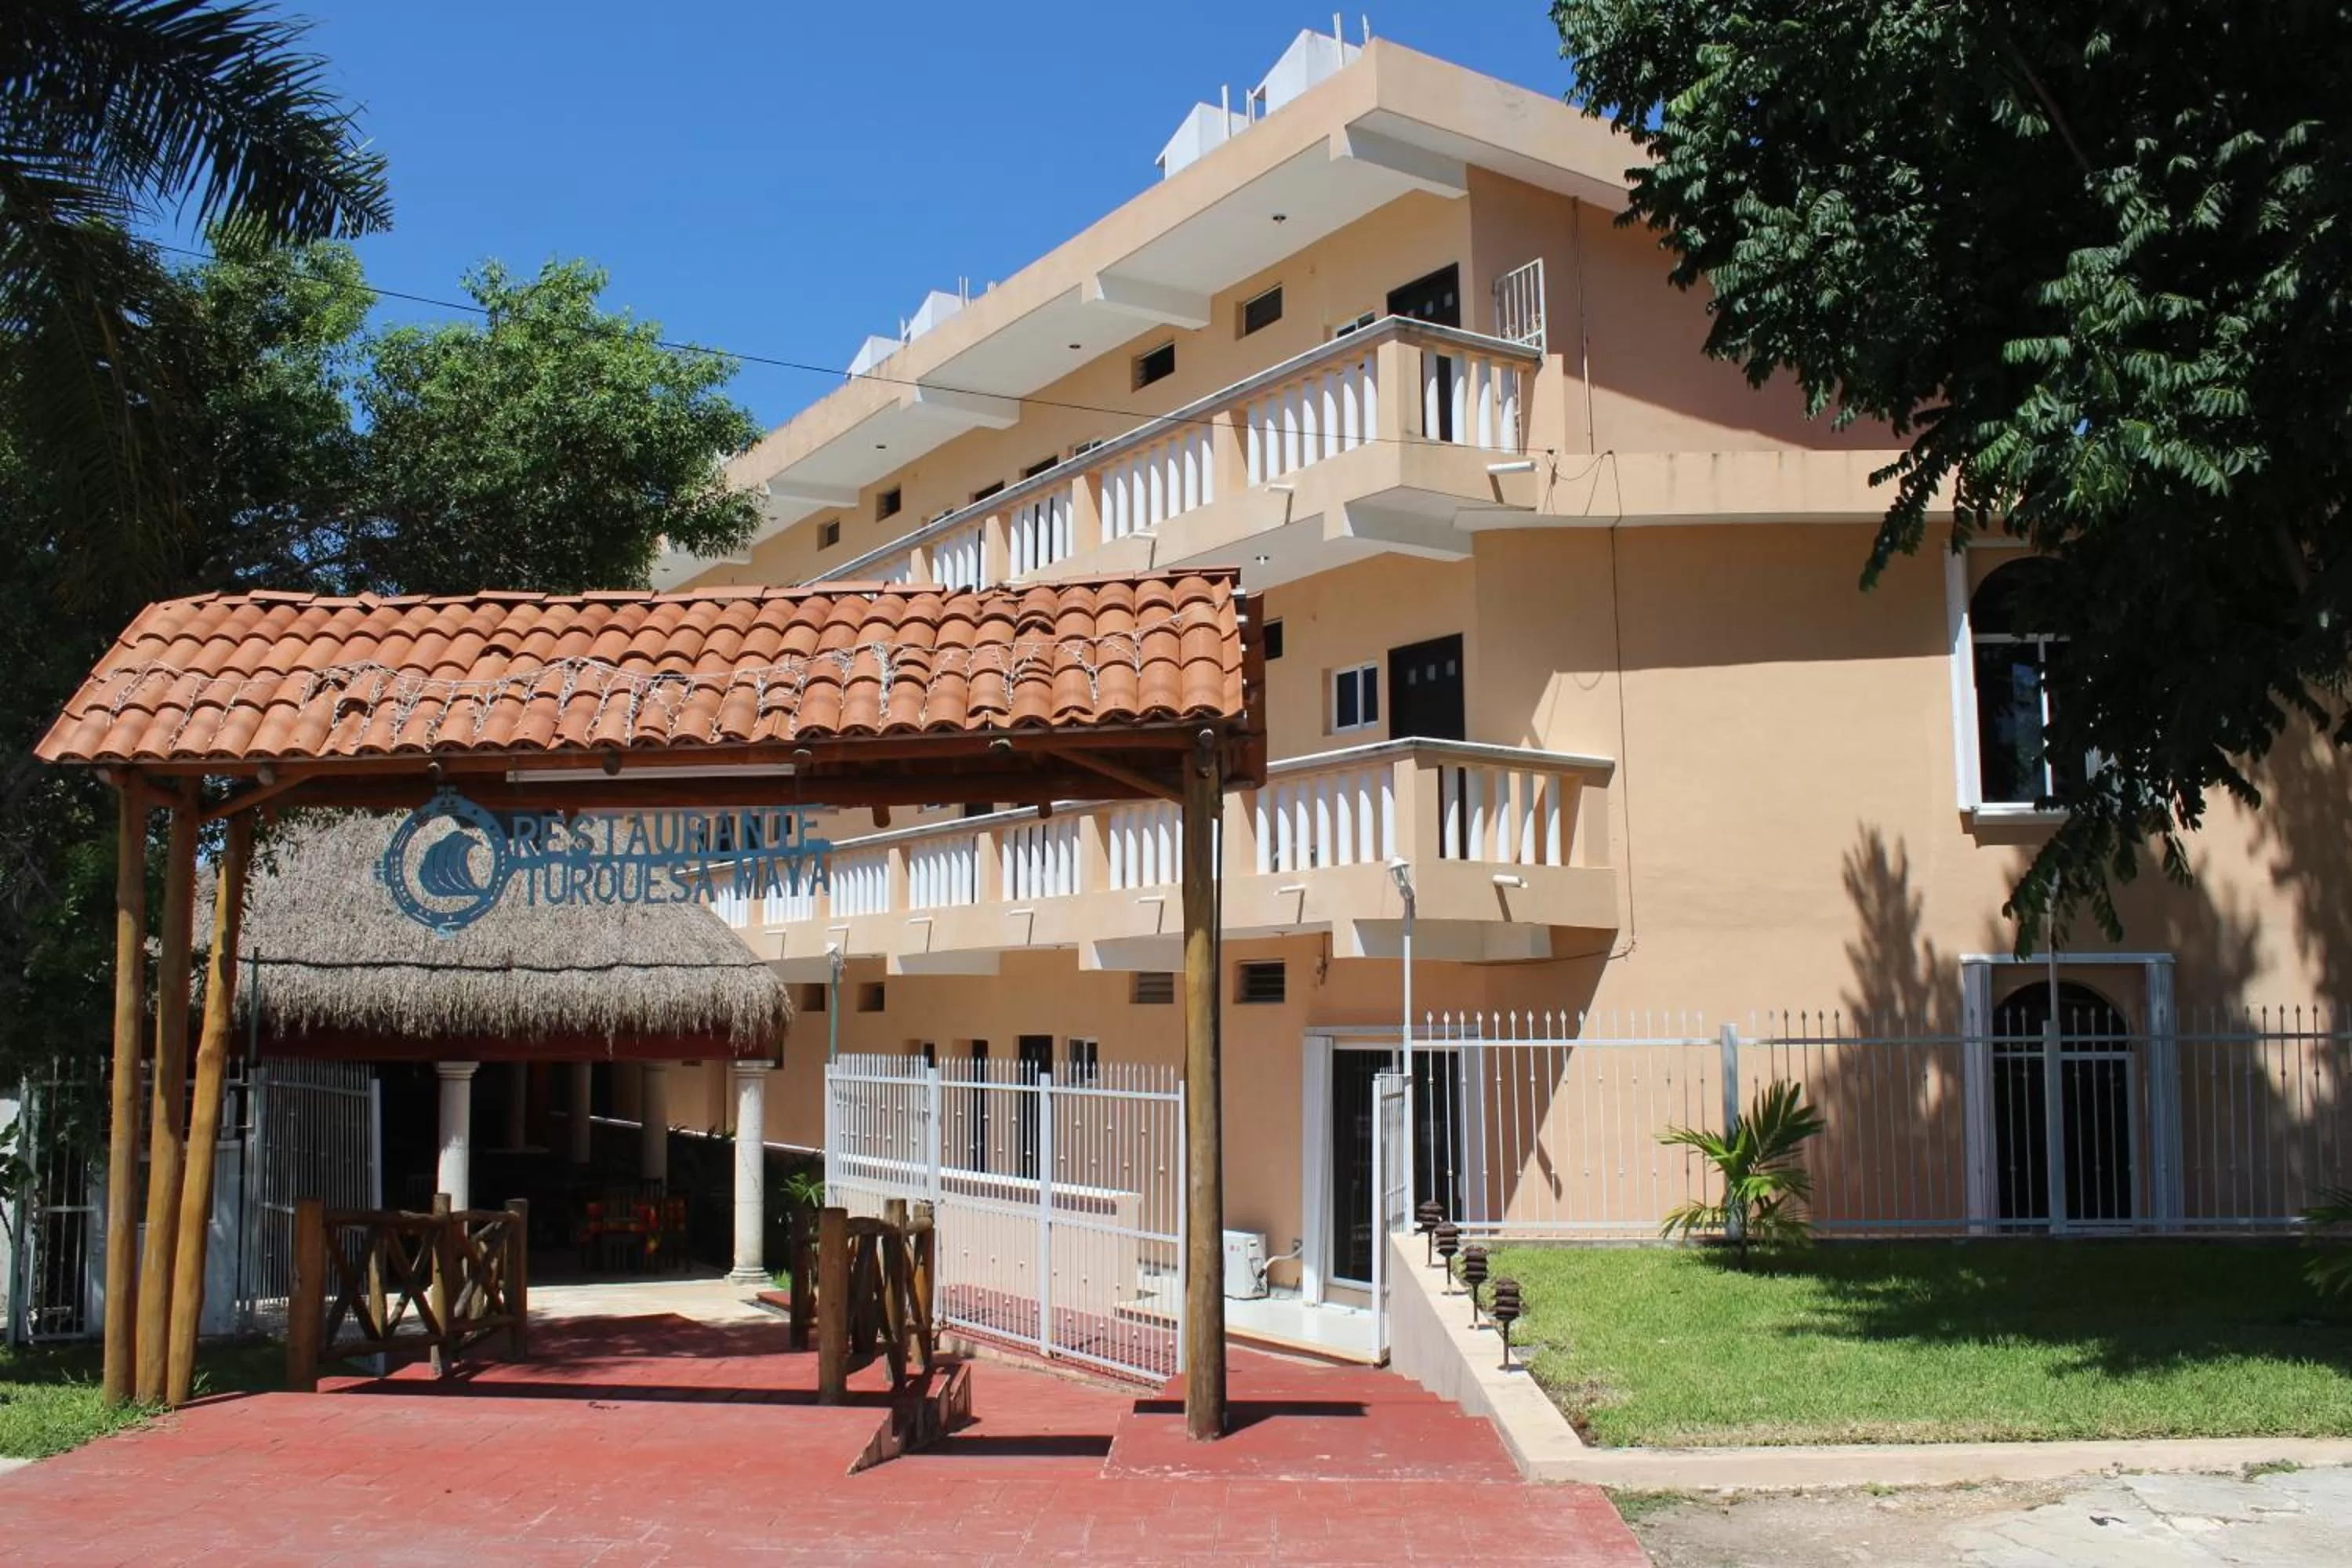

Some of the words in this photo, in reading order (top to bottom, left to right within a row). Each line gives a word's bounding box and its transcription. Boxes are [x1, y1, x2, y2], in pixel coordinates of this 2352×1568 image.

[512, 804, 831, 858] RESTAURANTE
[521, 856, 715, 906] TURQUESA
[735, 848, 831, 901] MAYA
